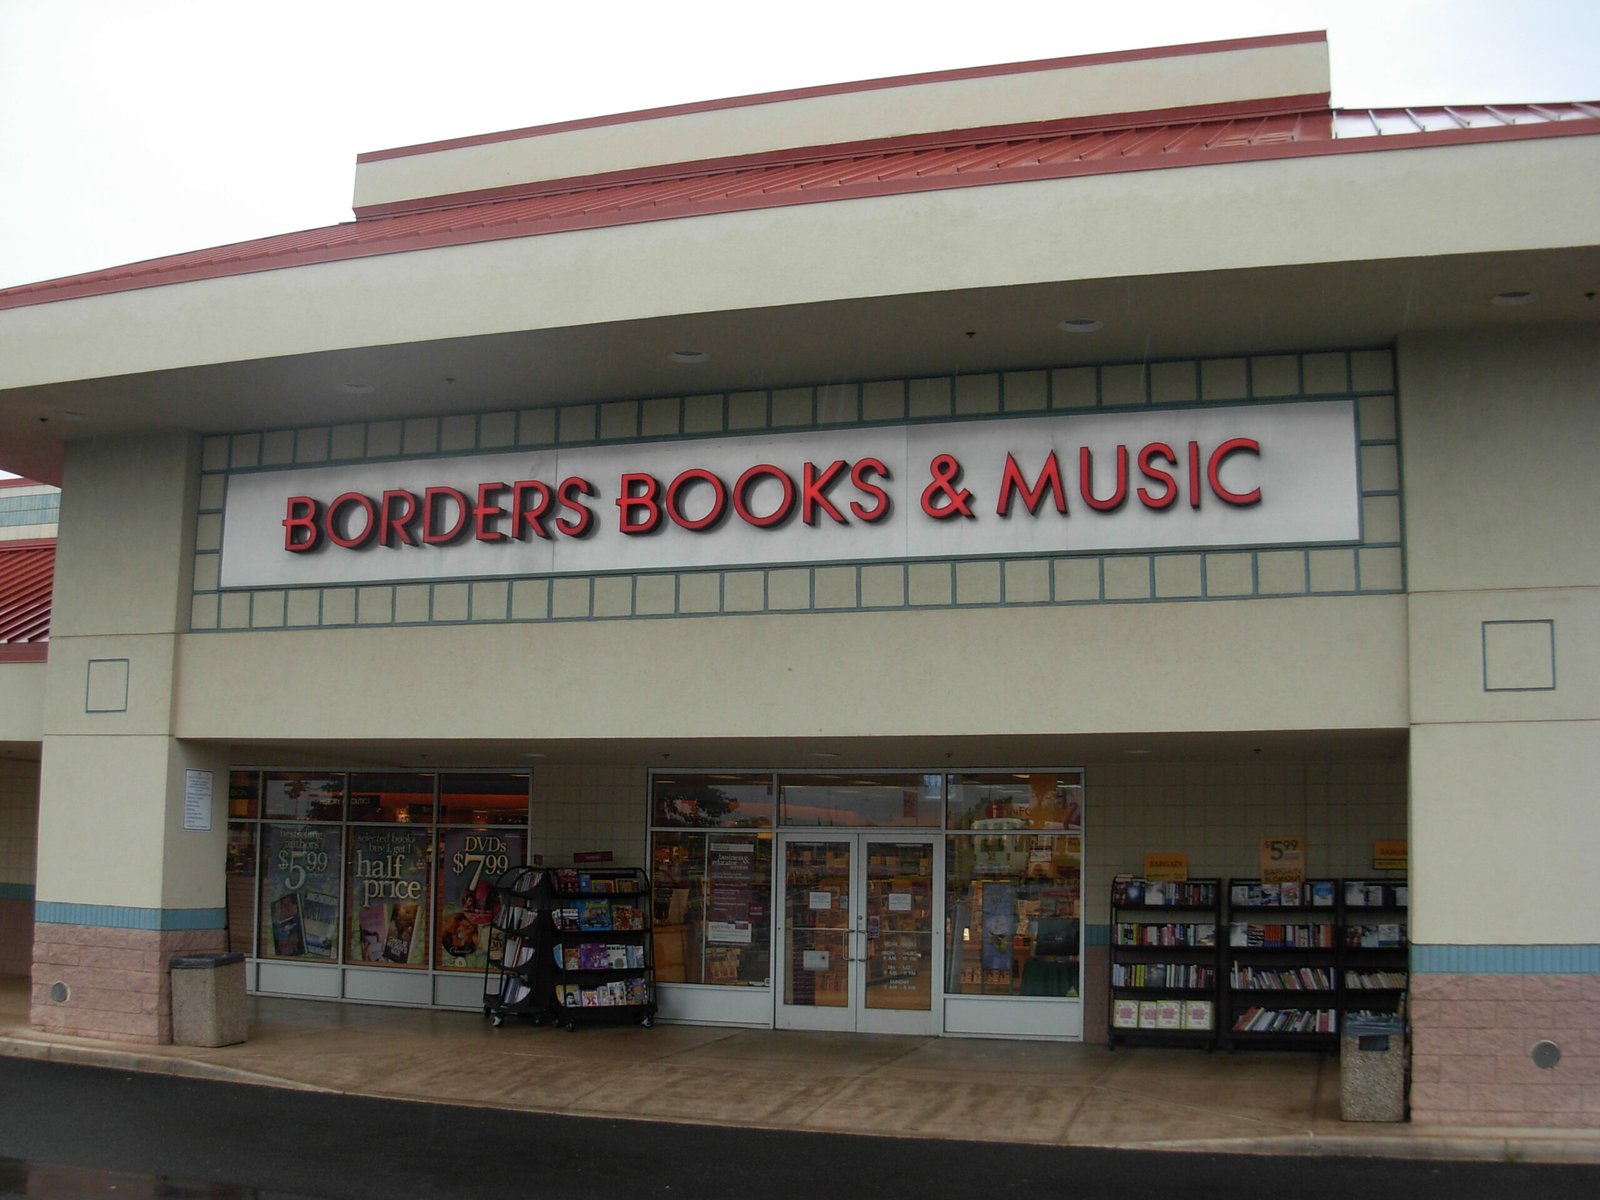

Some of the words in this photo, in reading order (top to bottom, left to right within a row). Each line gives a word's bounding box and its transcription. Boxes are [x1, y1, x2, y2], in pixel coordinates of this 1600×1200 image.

[282, 475, 594, 554] BORDERS
[616, 456, 890, 534] BOOKS
[920, 453, 975, 519] &
[996, 437, 1263, 517] MUSIC
[391, 832, 416, 843] books
[464, 836, 507, 852] DVDs
[356, 849, 405, 879] half
[363, 878, 422, 908] price
